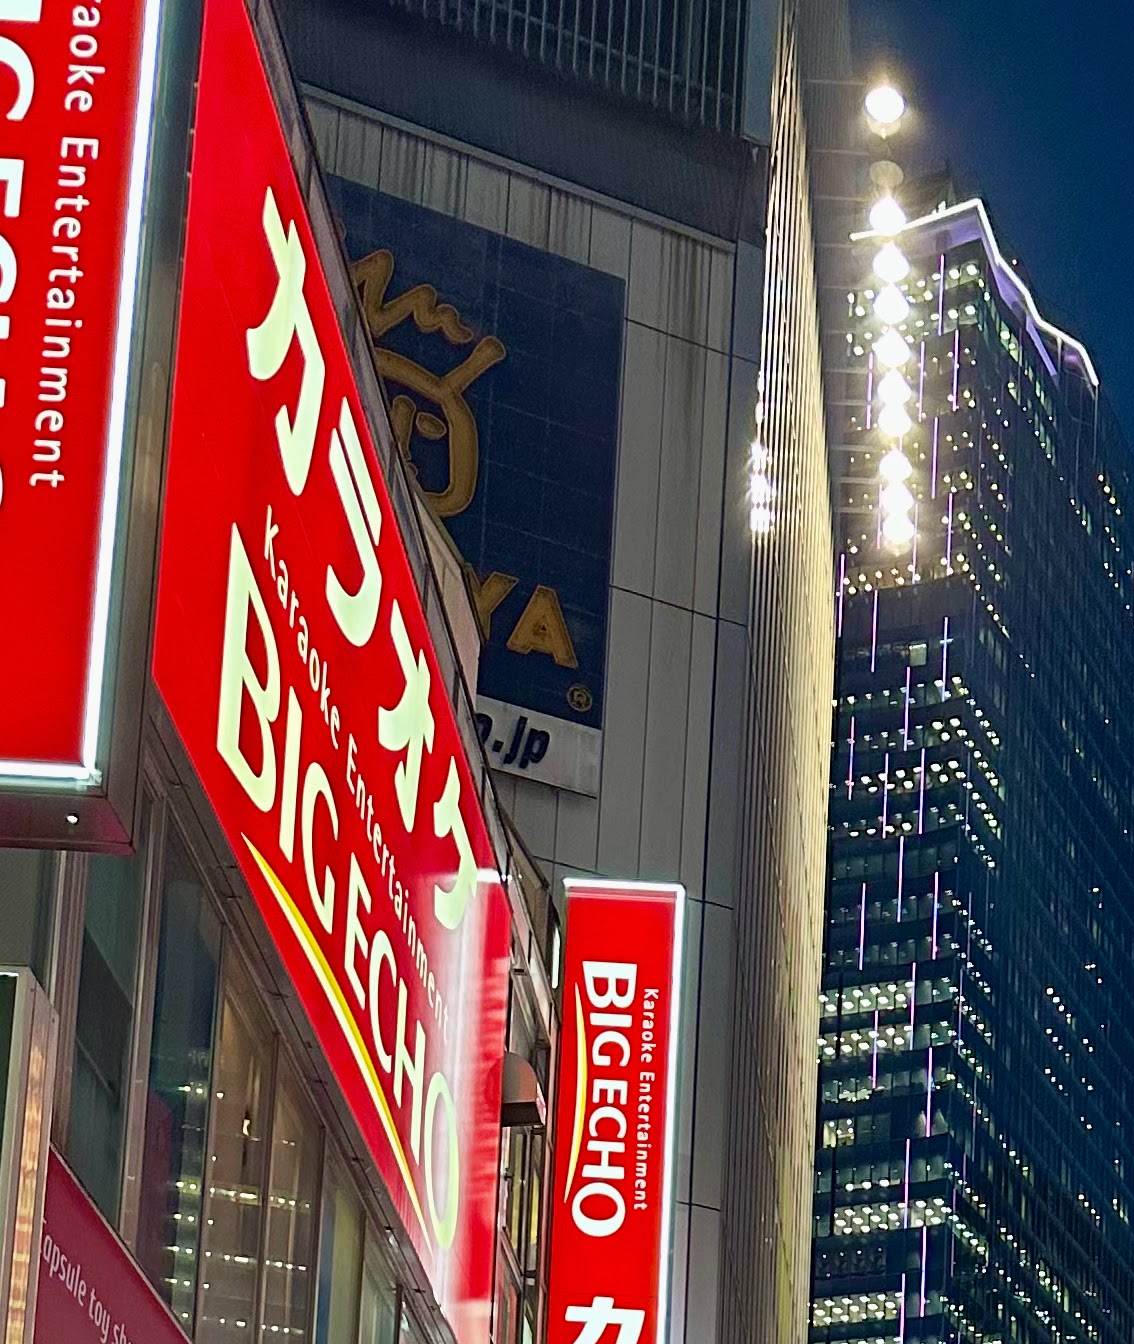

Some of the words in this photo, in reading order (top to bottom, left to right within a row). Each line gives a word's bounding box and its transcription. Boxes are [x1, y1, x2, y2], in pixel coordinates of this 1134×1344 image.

[64, 0, 100, 113] aoke
[30, 136, 99, 489] Entertainment
[248, 186, 478, 930] カラオケ
[264, 504, 341, 750] Karaoke
[346, 731, 455, 1048] Entertainment
[216, 522, 341, 934] BIG
[344, 853, 458, 1251] ECHO
[582, 960, 638, 1066] BIG
[640, 987, 660, 1063] Karaoke
[571, 1079, 628, 1238] ECHO
[633, 1070, 656, 1211] Entertainment
[89, 1280, 110, 1342] toy
